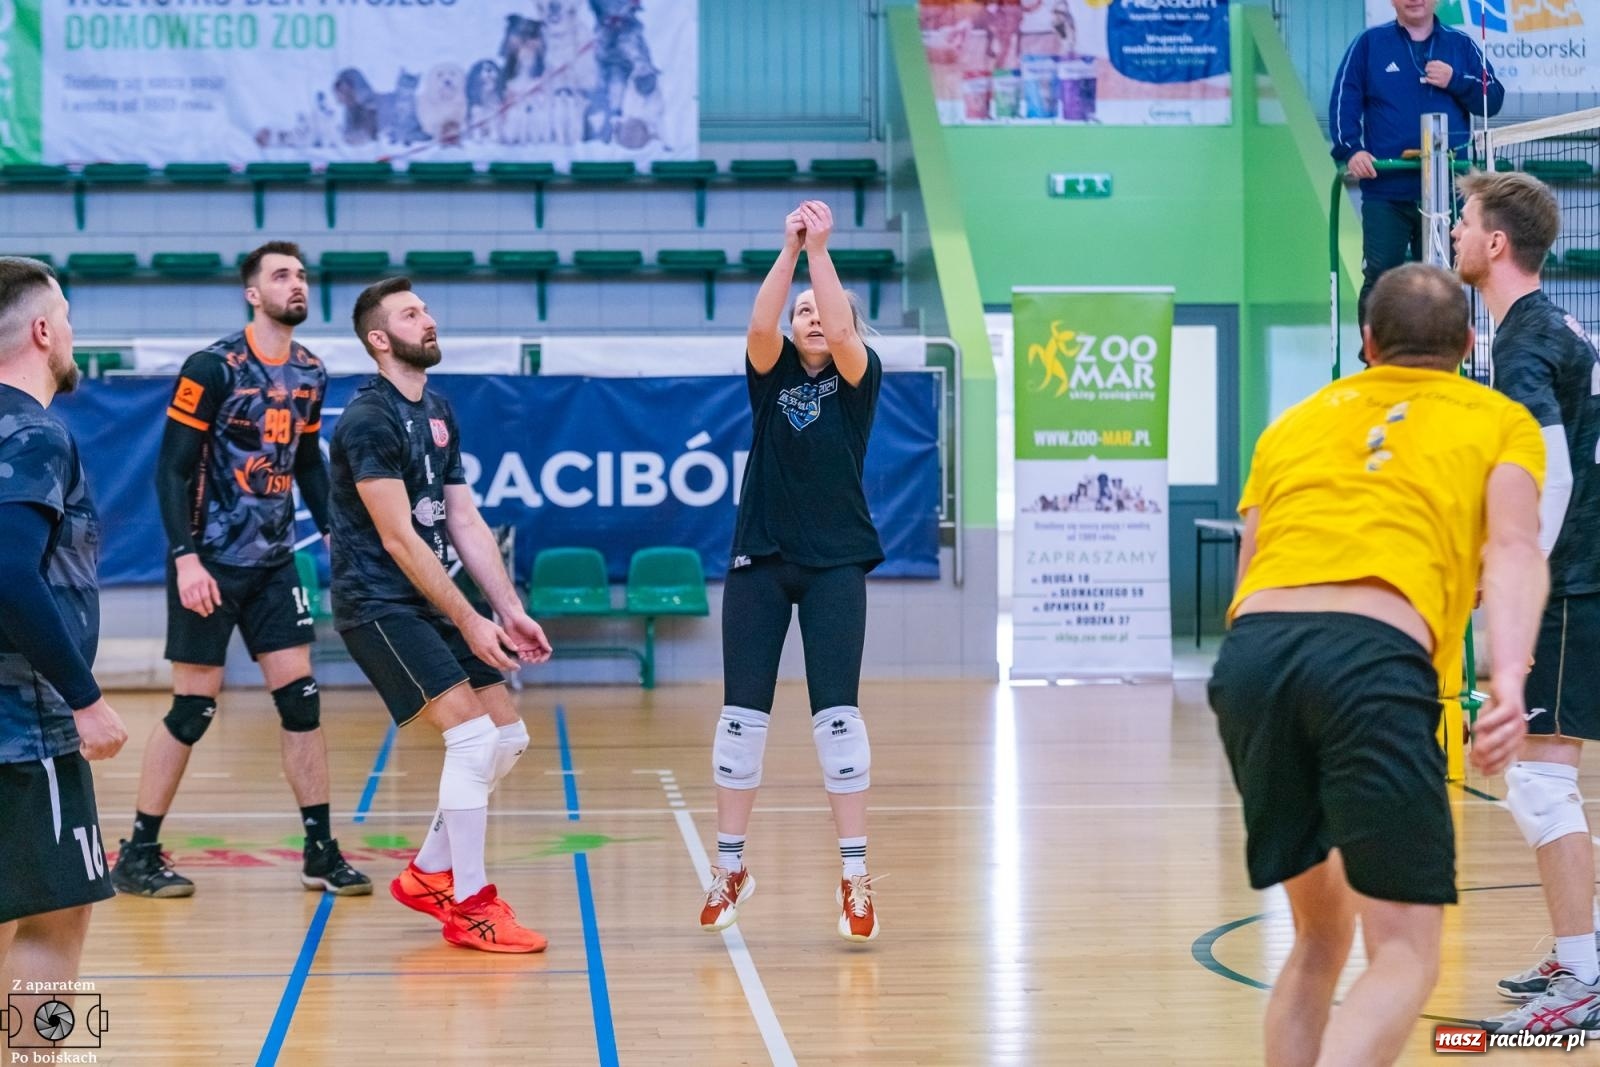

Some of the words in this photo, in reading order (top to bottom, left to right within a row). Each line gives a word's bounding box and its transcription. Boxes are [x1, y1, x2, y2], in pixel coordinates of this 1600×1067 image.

[64, 12, 259, 50] DOMOWEGO
[271, 12, 337, 49] ZOO
[1485, 37, 1586, 58] raciborski
[1075, 334, 1158, 363] ZOO
[819, 379, 835, 395] 2024
[1069, 362, 1156, 390] MAR
[1034, 430, 1152, 447] WWW.ZOO-MAR.PL
[460, 430, 750, 507] RACIBÓ
[1026, 551, 1158, 565] ZAPRASZAMY
